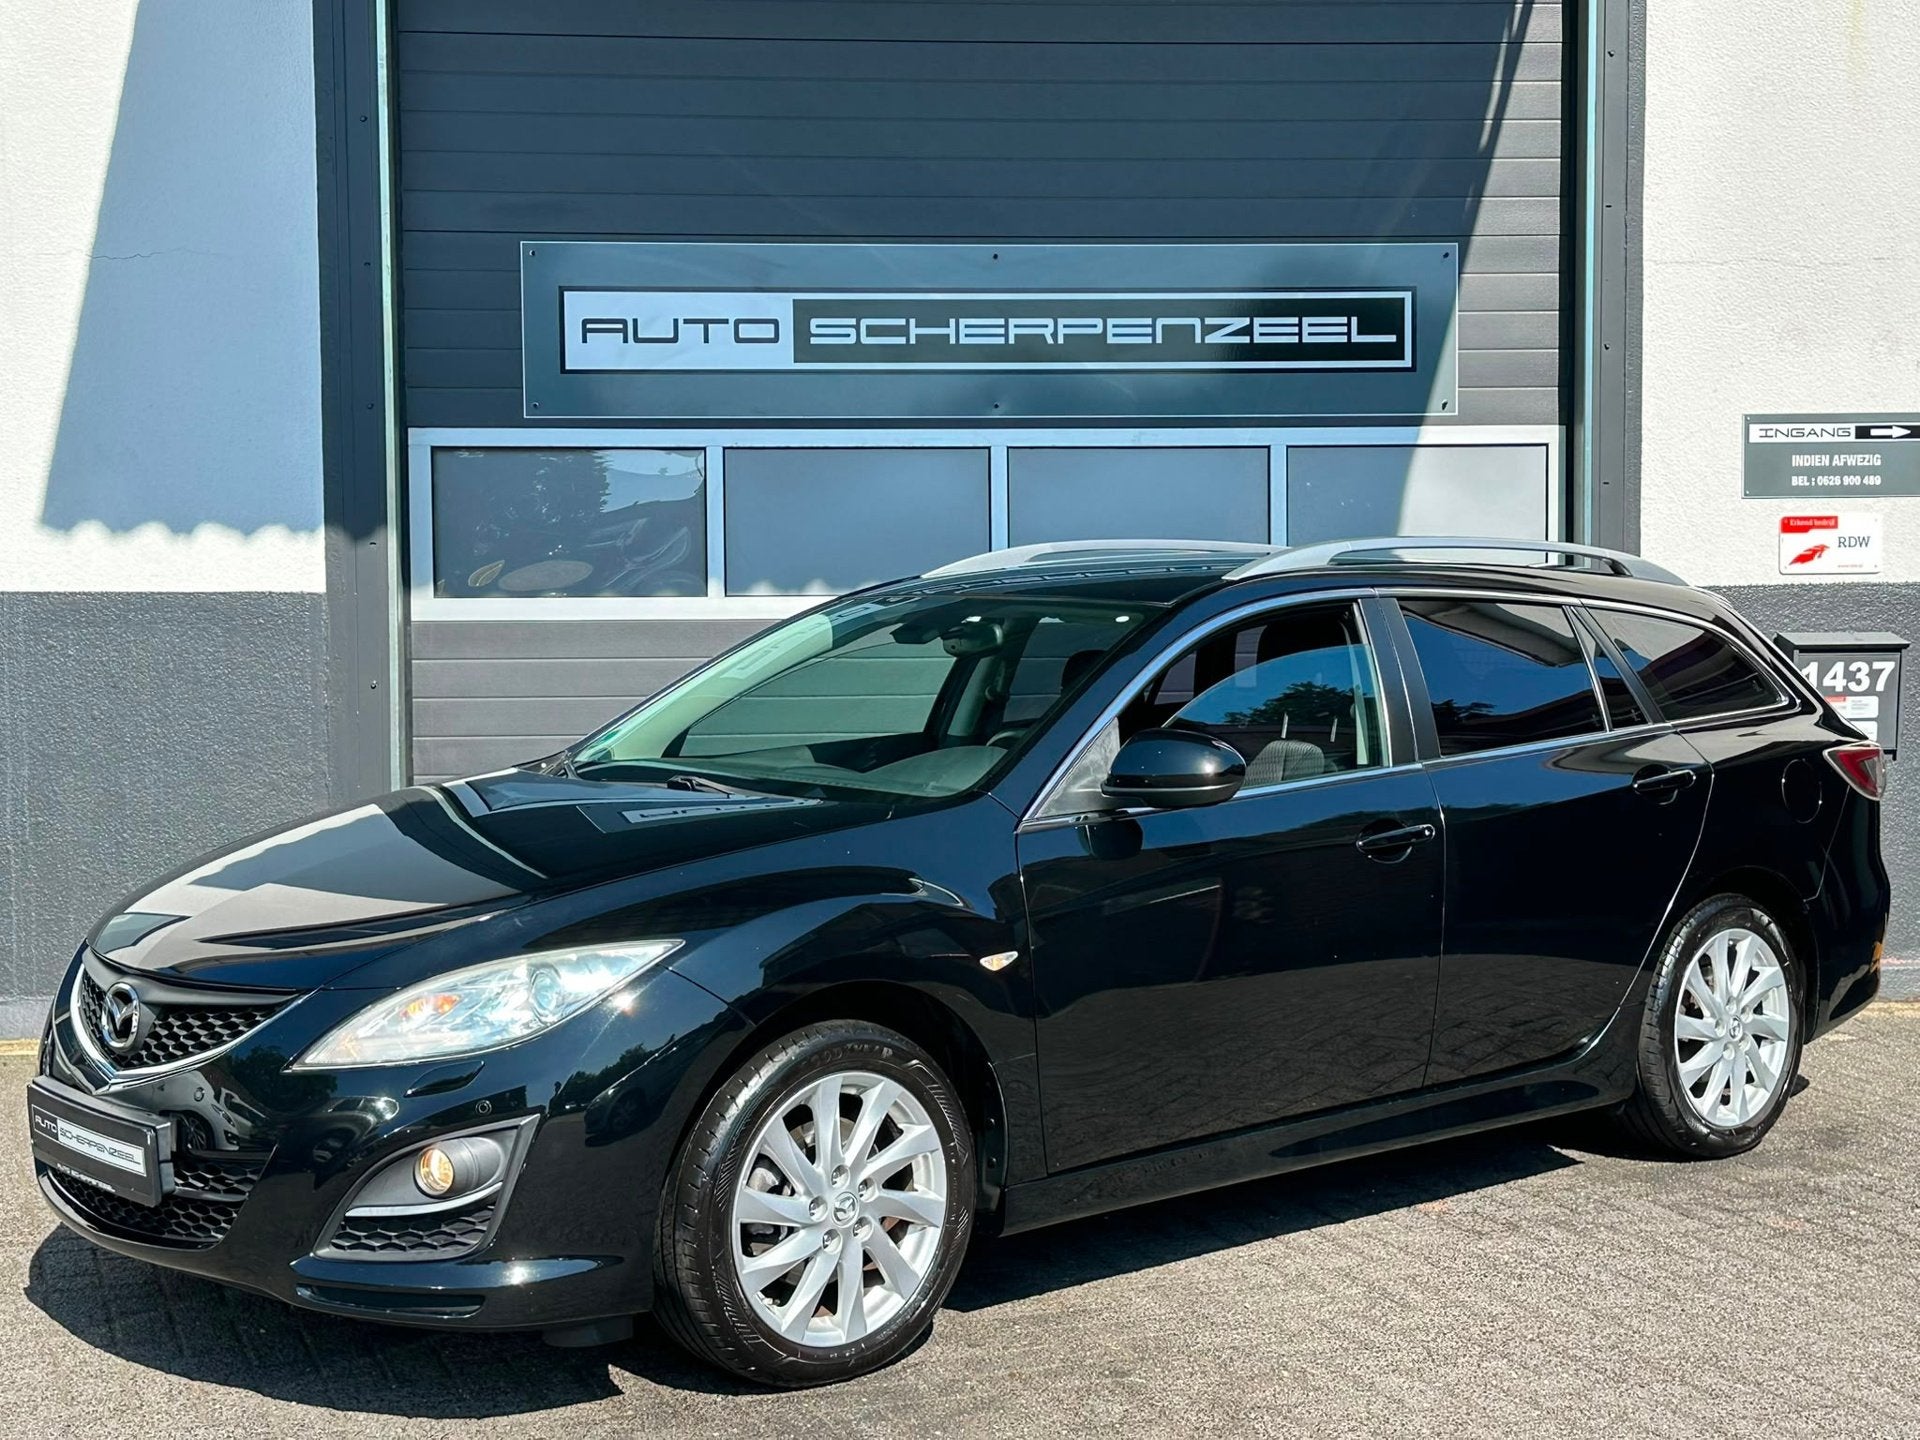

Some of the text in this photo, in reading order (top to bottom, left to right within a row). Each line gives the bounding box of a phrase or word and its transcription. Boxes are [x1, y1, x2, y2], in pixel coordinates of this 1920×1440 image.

[580, 315, 1398, 344] AUTO SCHERPENZEEL
[1759, 427, 1851, 438] INGANG
[1791, 454, 1882, 467] INDIEN AFWEZIG
[1791, 476, 1810, 486] BEL
[1842, 475, 1861, 486] 900
[1837, 536, 1871, 548] RDW
[1801, 661, 1896, 692] 1437
[34, 1114, 58, 1134] AUTO
